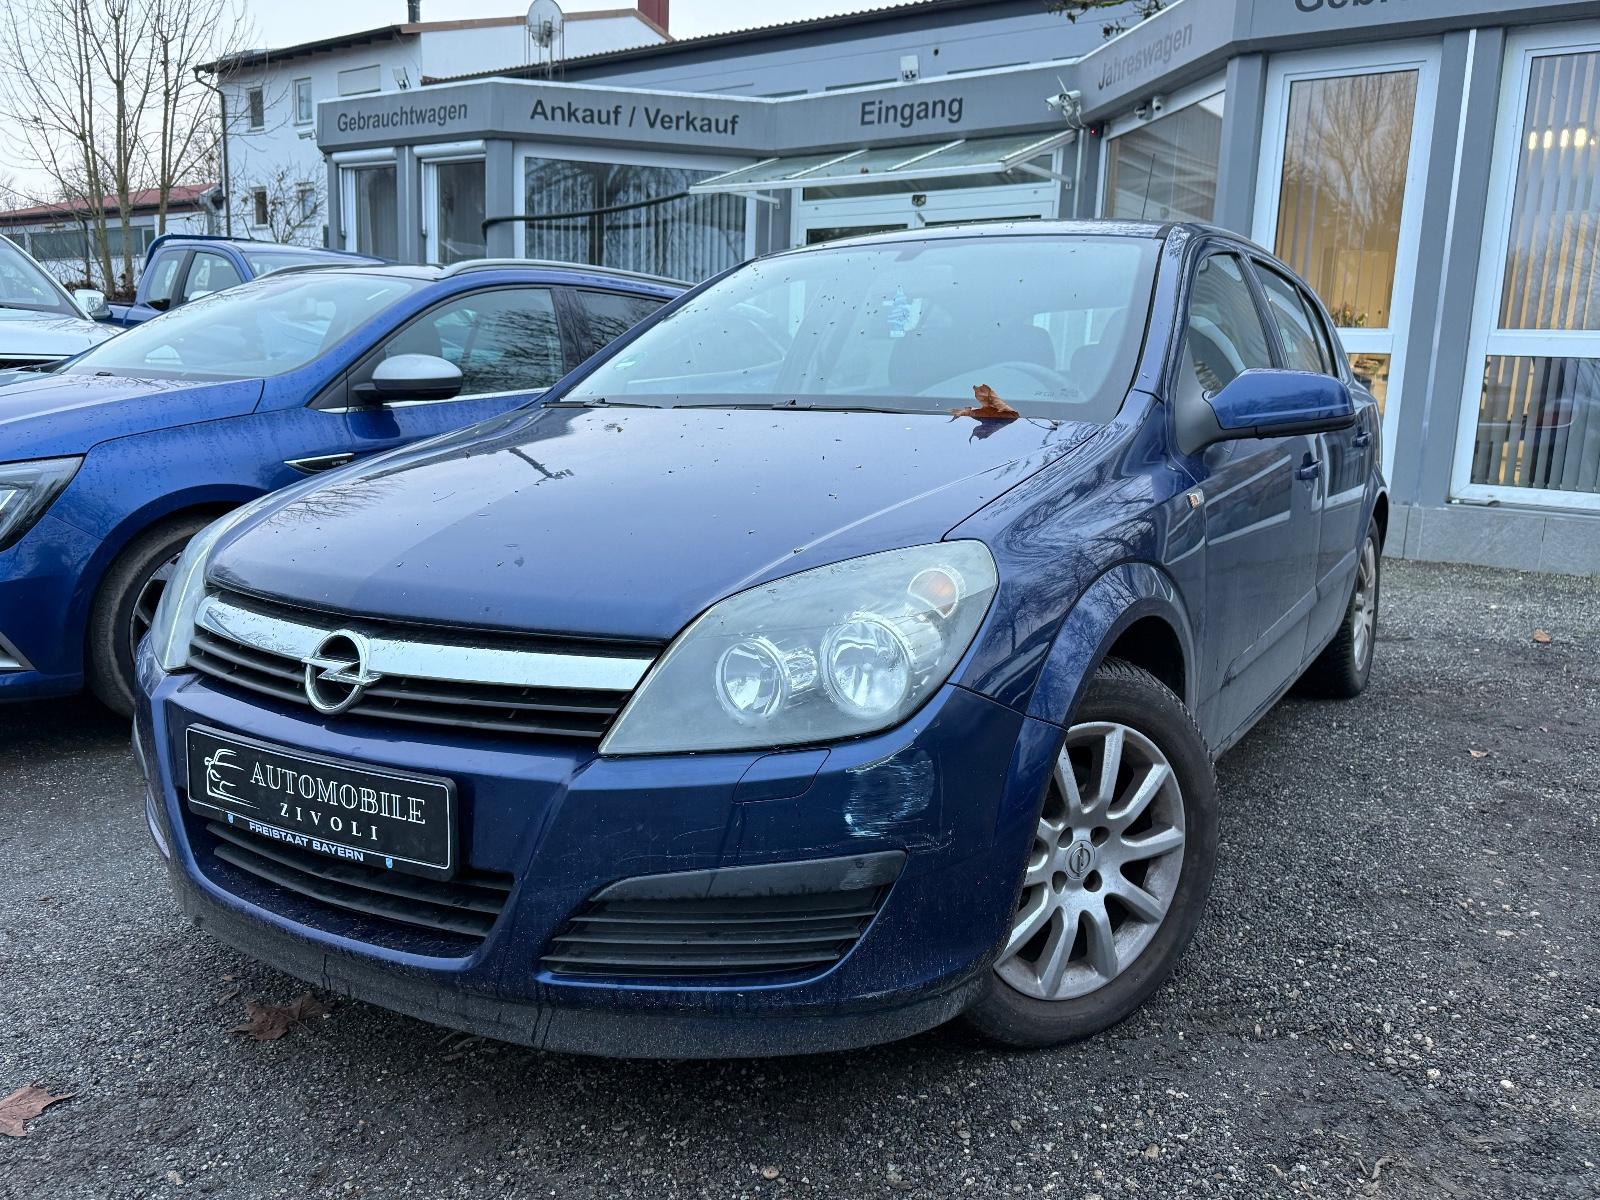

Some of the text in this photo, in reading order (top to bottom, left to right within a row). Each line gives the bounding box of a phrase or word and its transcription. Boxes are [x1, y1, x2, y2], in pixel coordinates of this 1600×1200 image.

[1098, 24, 1194, 91] Jahreswagen
[337, 103, 468, 132] Gebrauchtwagen
[530, 99, 740, 136] Ankauf / Verkauf
[860, 97, 964, 129] Eingang
[250, 761, 426, 825] AUTOMOBILE
[279, 802, 378, 841] ZIVOLI
[249, 822, 364, 862] FREISTAAT BAYERN
